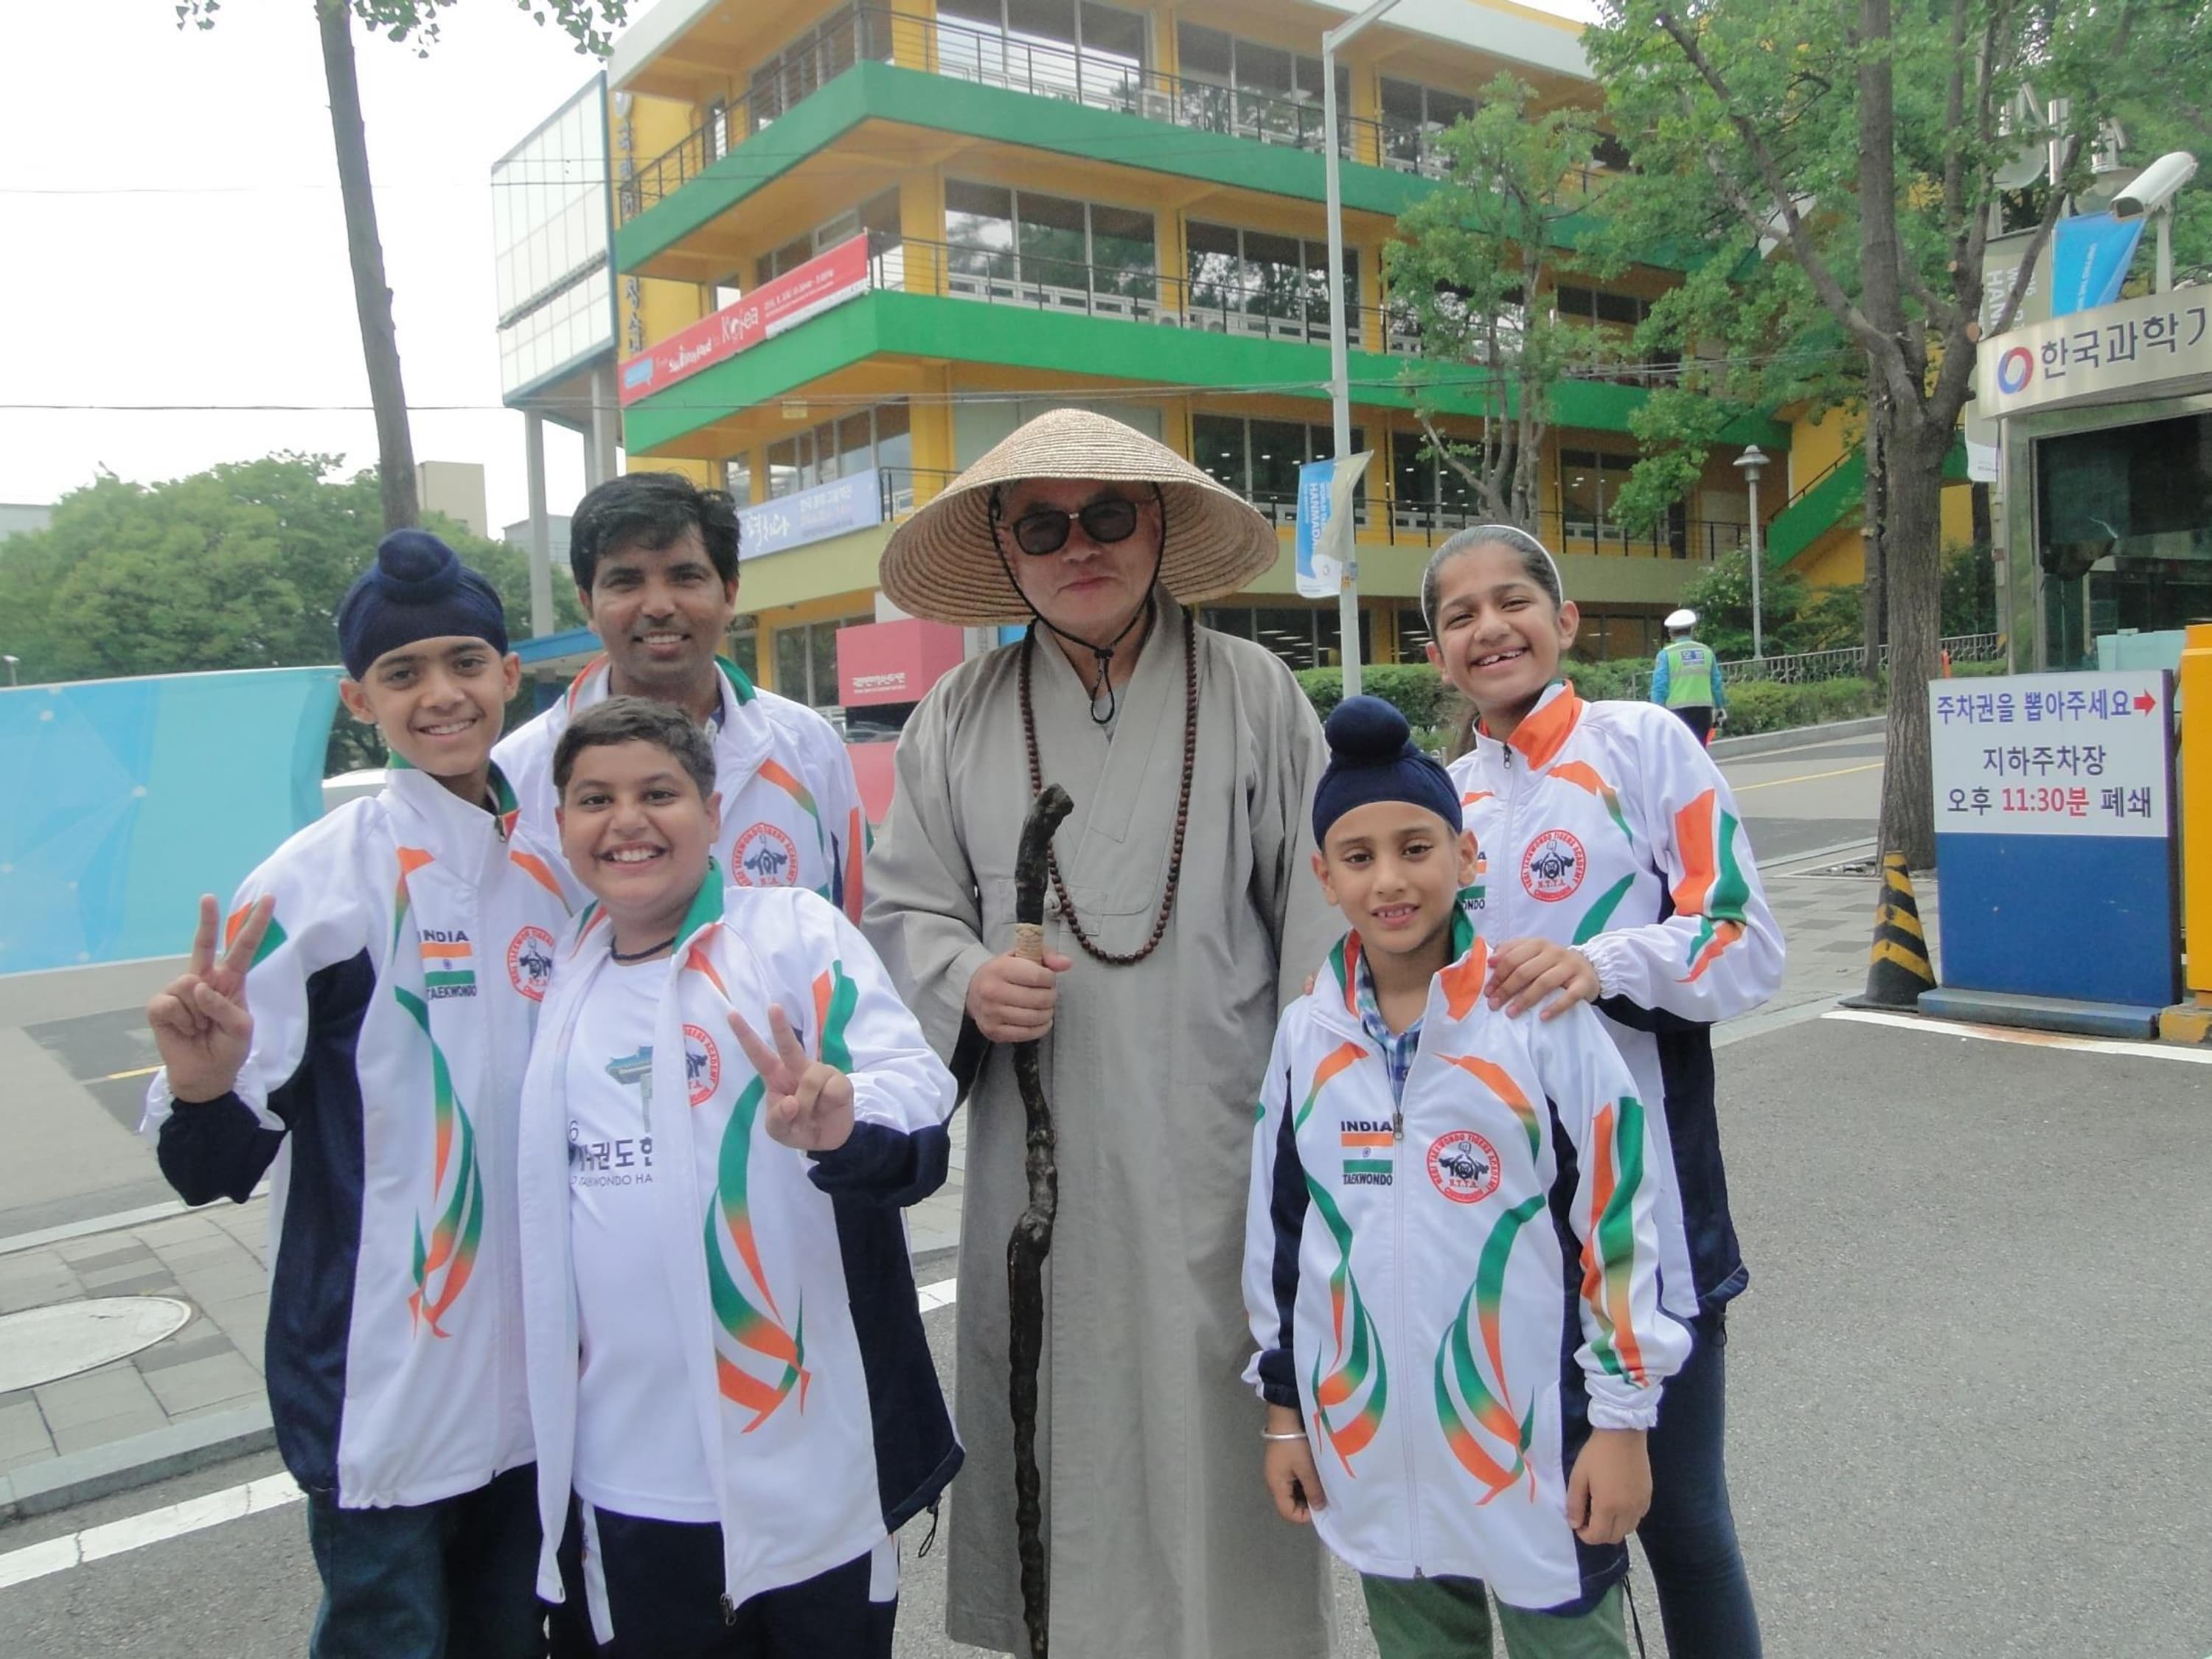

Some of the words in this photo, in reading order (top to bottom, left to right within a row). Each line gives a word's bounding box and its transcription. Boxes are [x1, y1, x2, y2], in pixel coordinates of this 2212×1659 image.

[1937, 692, 2016, 725] 주차권을
[2025, 689, 2132, 722] 뽑아주세요
[1983, 745, 2107, 776] 지하주차장
[1947, 786, 1992, 815] 오후
[2003, 787, 2090, 816] 11:30분
[2101, 786, 2152, 818] 폐쇄
[418, 929, 470, 943] INDIA
[1340, 1120, 1394, 1132] INDIA
[1343, 1173, 1394, 1186] TAEKWONDO
